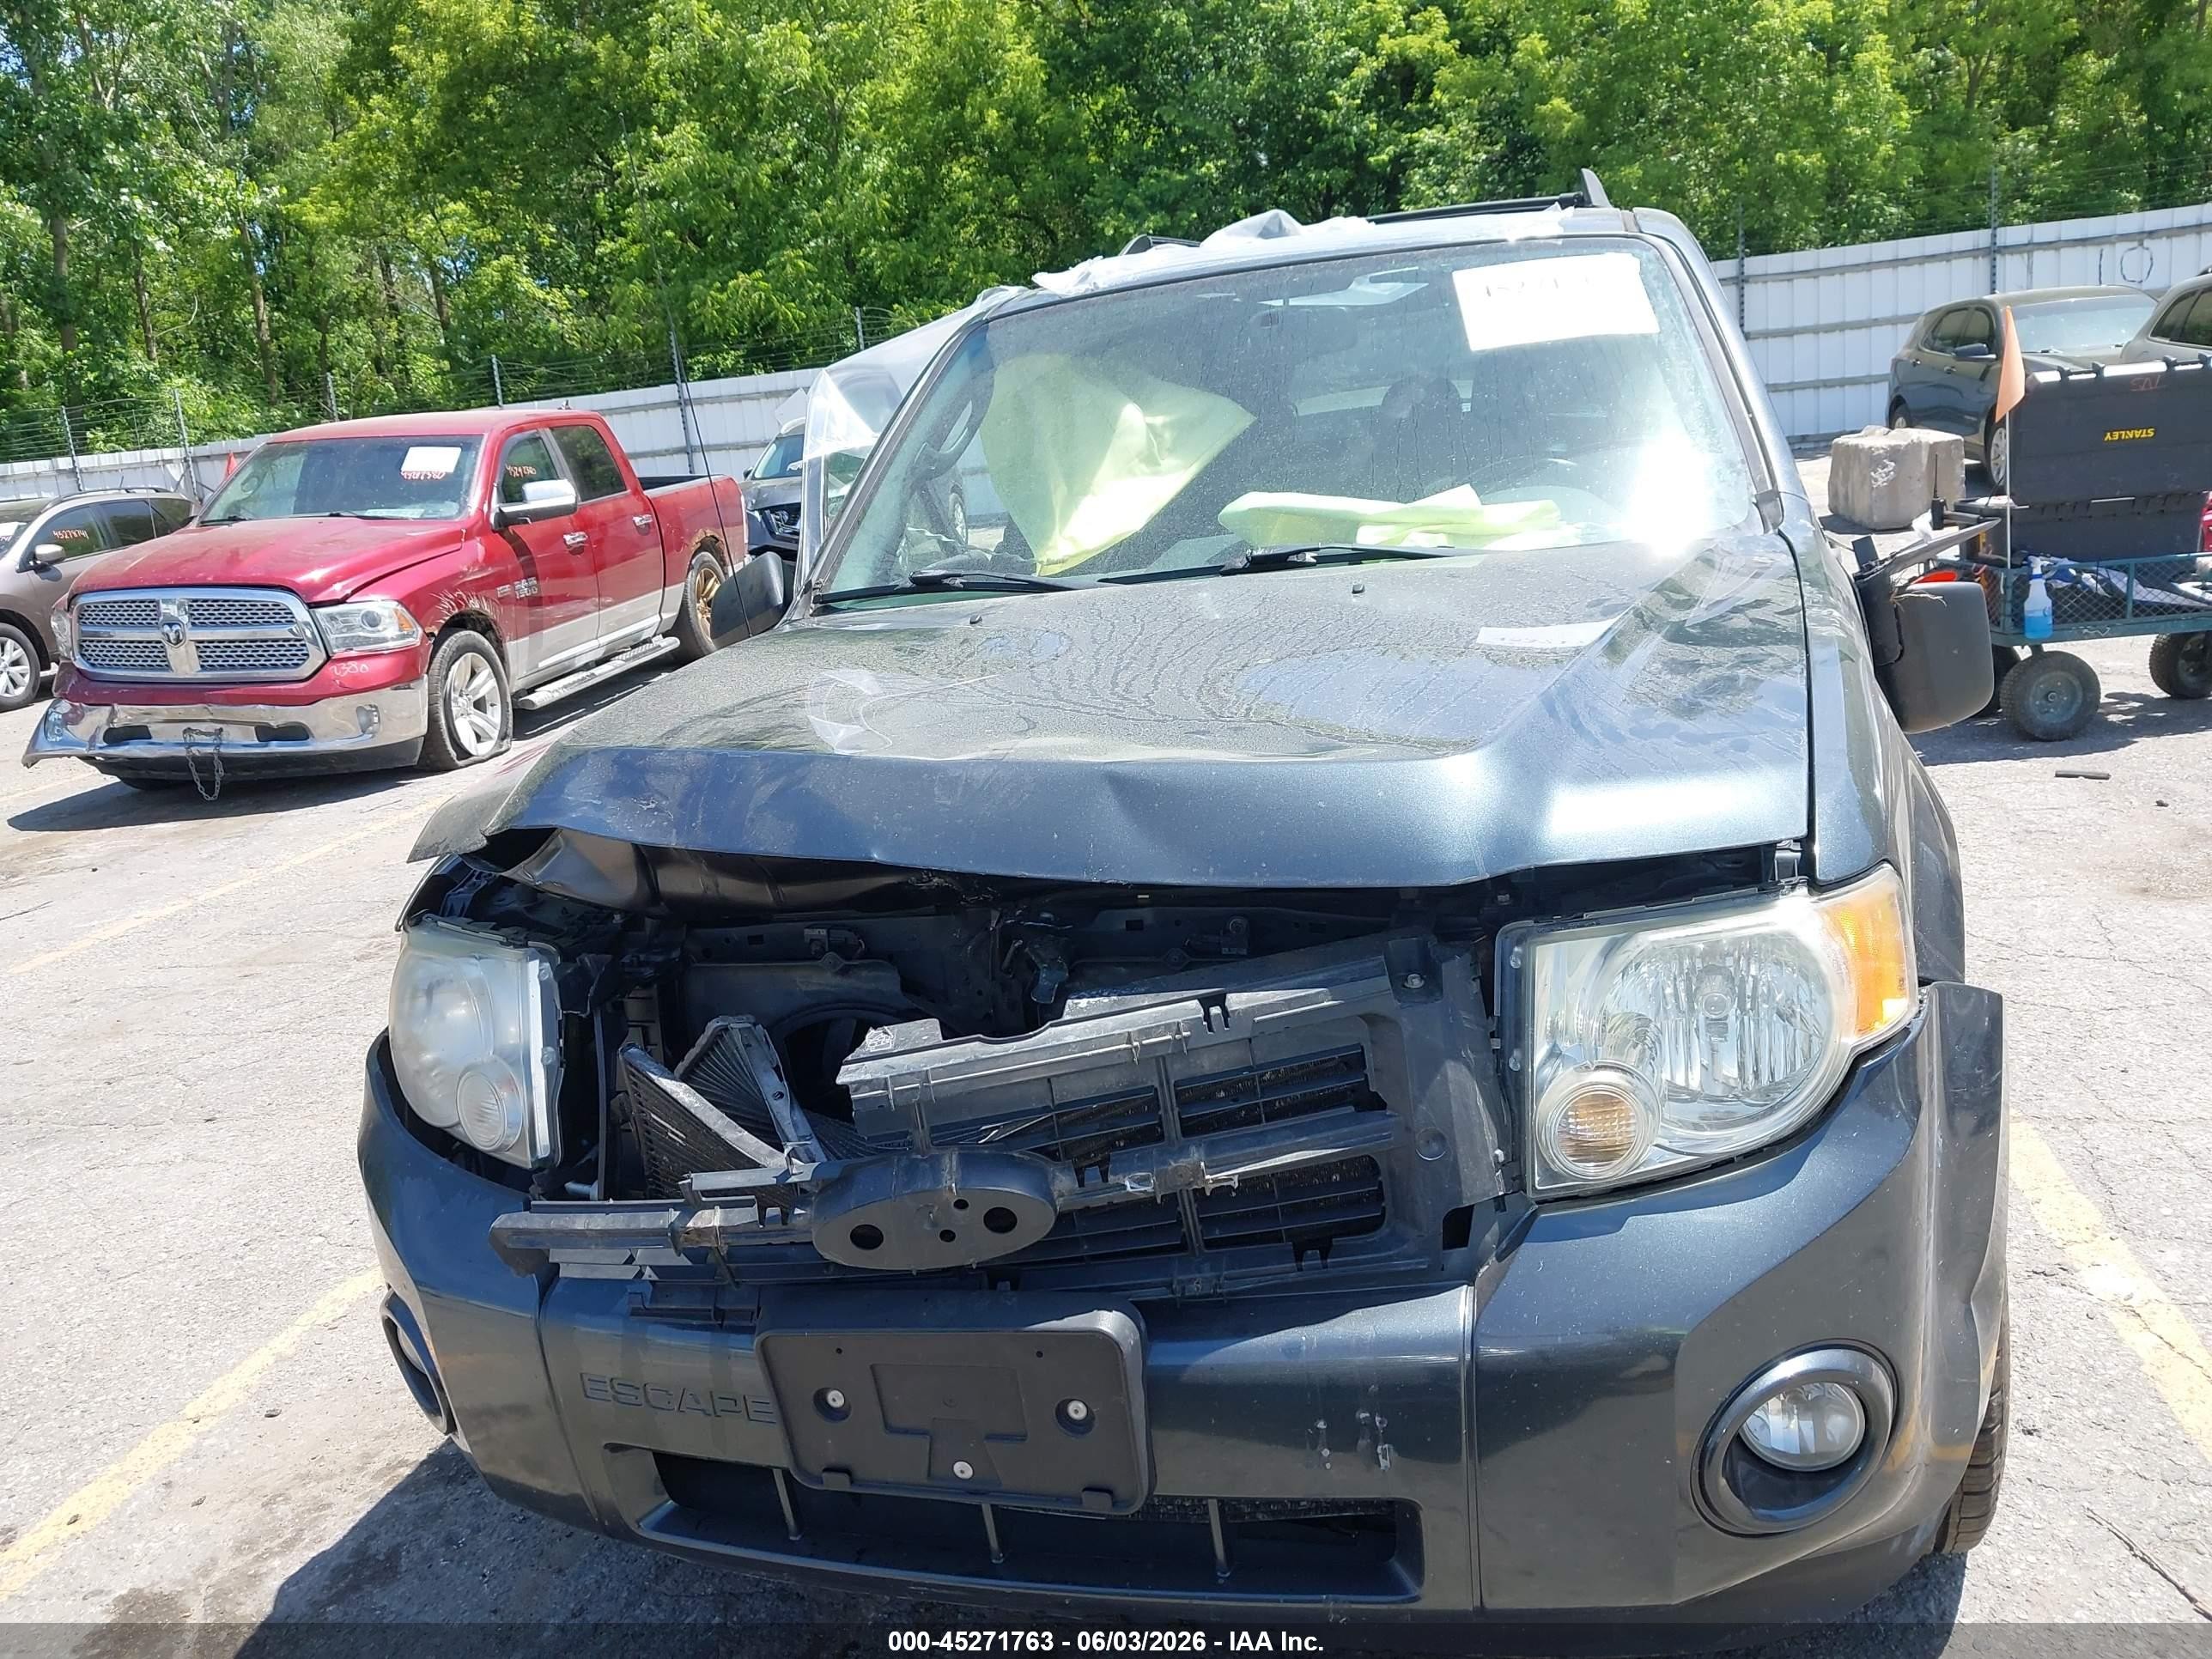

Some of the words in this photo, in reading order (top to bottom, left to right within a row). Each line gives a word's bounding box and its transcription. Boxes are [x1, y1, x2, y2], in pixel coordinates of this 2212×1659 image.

[2104, 428, 2155, 441] STANLEY
[52, 529, 89, 540] 45278741
[580, 1372, 776, 1425] ESCAPE
